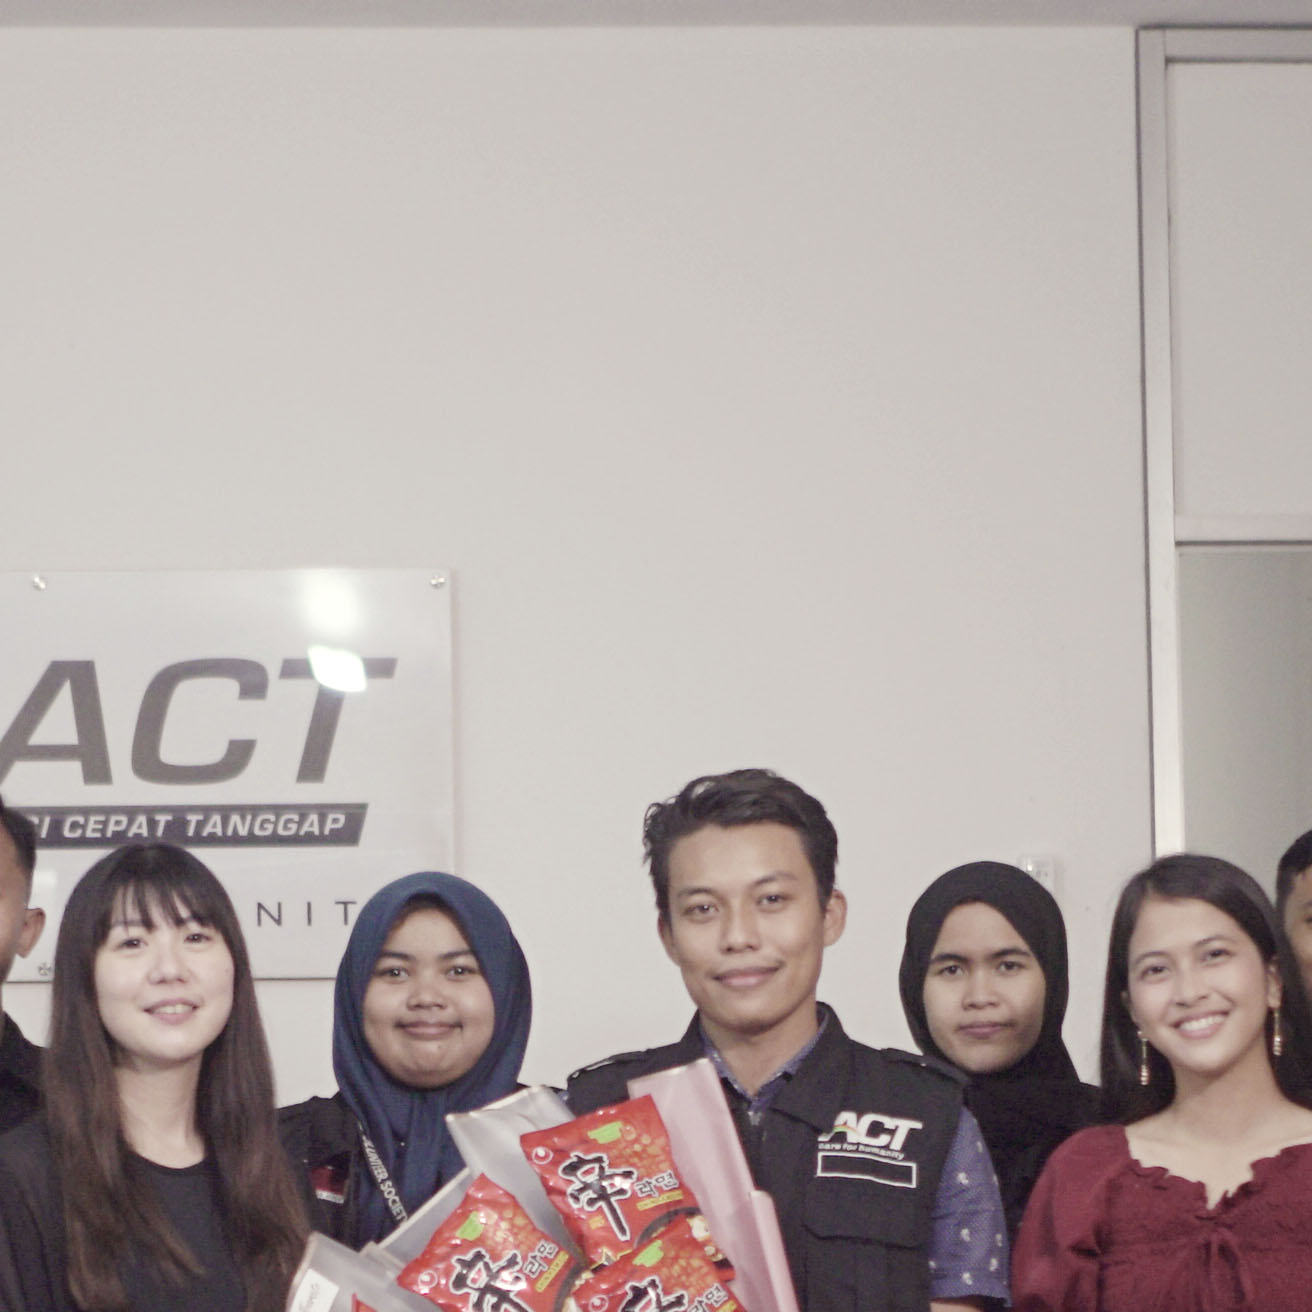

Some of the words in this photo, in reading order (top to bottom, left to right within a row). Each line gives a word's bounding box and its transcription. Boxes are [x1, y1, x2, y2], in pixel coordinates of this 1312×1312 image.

[62, 814, 173, 839] CEPAT
[186, 812, 346, 838] TANGGAP
[817, 1110, 924, 1151] ACT
[858, 1144, 905, 1161] humanity
[560, 1151, 636, 1241] 辛
[636, 1169, 680, 1197] 라면
[523, 1240, 559, 1278] 라면
